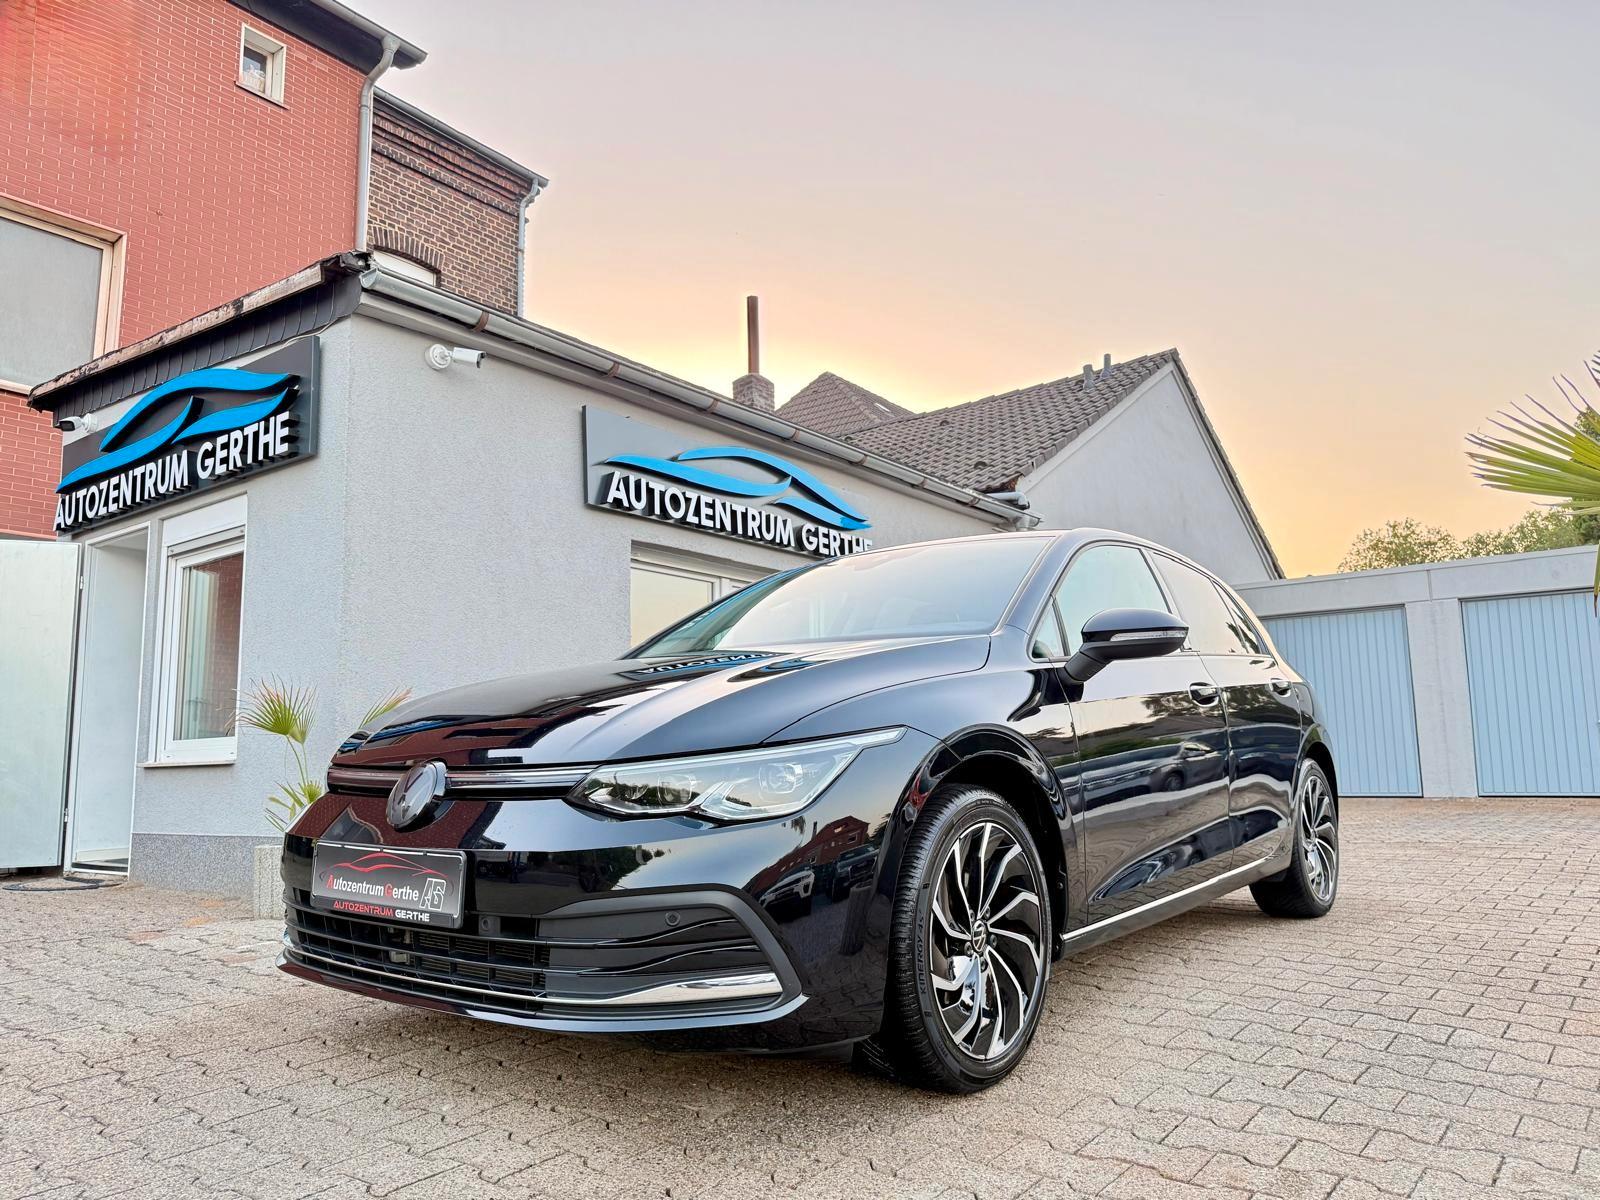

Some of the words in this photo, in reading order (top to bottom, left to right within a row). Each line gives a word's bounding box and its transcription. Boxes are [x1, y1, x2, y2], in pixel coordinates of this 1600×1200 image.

[53, 450, 188, 531] AUTOZENTRUM
[197, 411, 290, 479] GERTHE
[607, 471, 795, 547] AUTOZENTRUM
[326, 874, 384, 897] Autozentrum
[385, 884, 419, 901] Gerthe
[334, 901, 393, 917] AUTOZENTRUM
[395, 909, 430, 922] GERTHE
